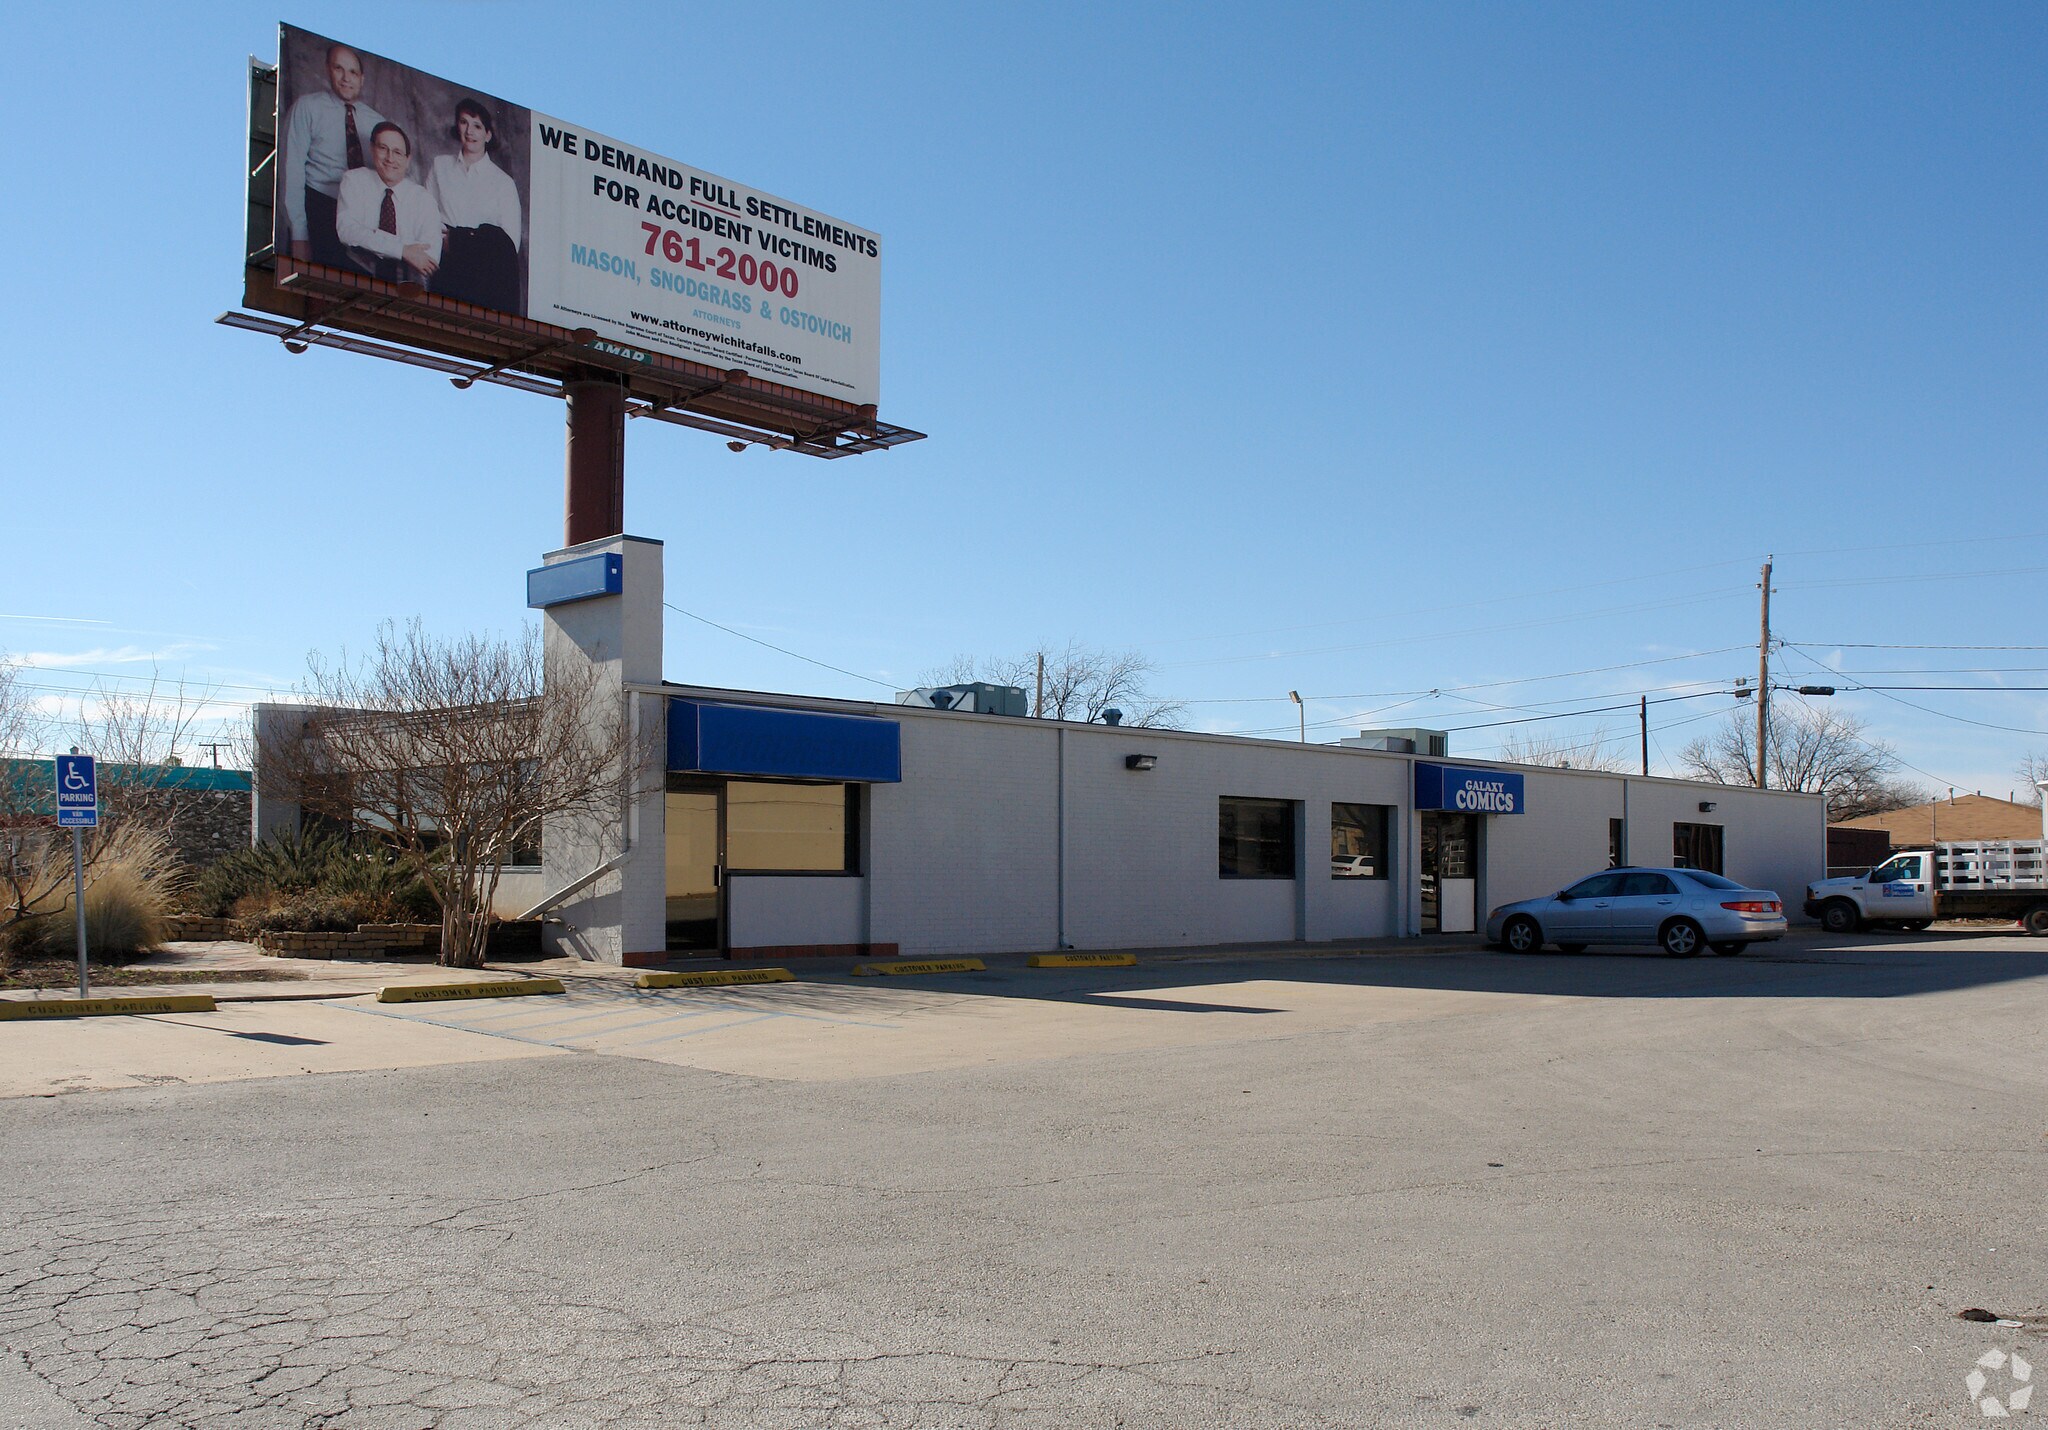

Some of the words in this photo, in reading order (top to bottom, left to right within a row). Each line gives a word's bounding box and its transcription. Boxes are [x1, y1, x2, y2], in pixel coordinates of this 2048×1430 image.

[539, 123, 578, 156] WE
[584, 138, 683, 190] DEMAND
[690, 176, 741, 211] FULL
[746, 196, 878, 258] SETTLEMENTS
[593, 174, 640, 209] FOR
[646, 194, 752, 245] ACCIDENT
[758, 229, 837, 273] VICTIMS
[641, 220, 799, 299] 761-2000
[571, 243, 641, 286] MASON,
[650, 267, 752, 314] SNODGRASS
[759, 301, 772, 320] &
[780, 306, 852, 344] OSTOVICH
[692, 308, 741, 330] ATTORNEYS
[630, 310, 802, 365] www.attorneywichitafalls.com
[1465, 780, 1504, 792] GALAXY
[60, 793, 94, 802] PARKING
[1456, 789, 1514, 812] COMICS
[731, 973, 768, 982] PARKING
[894, 965, 931, 973] CUSTOMER
[414, 989, 471, 999] CUSTOMER
